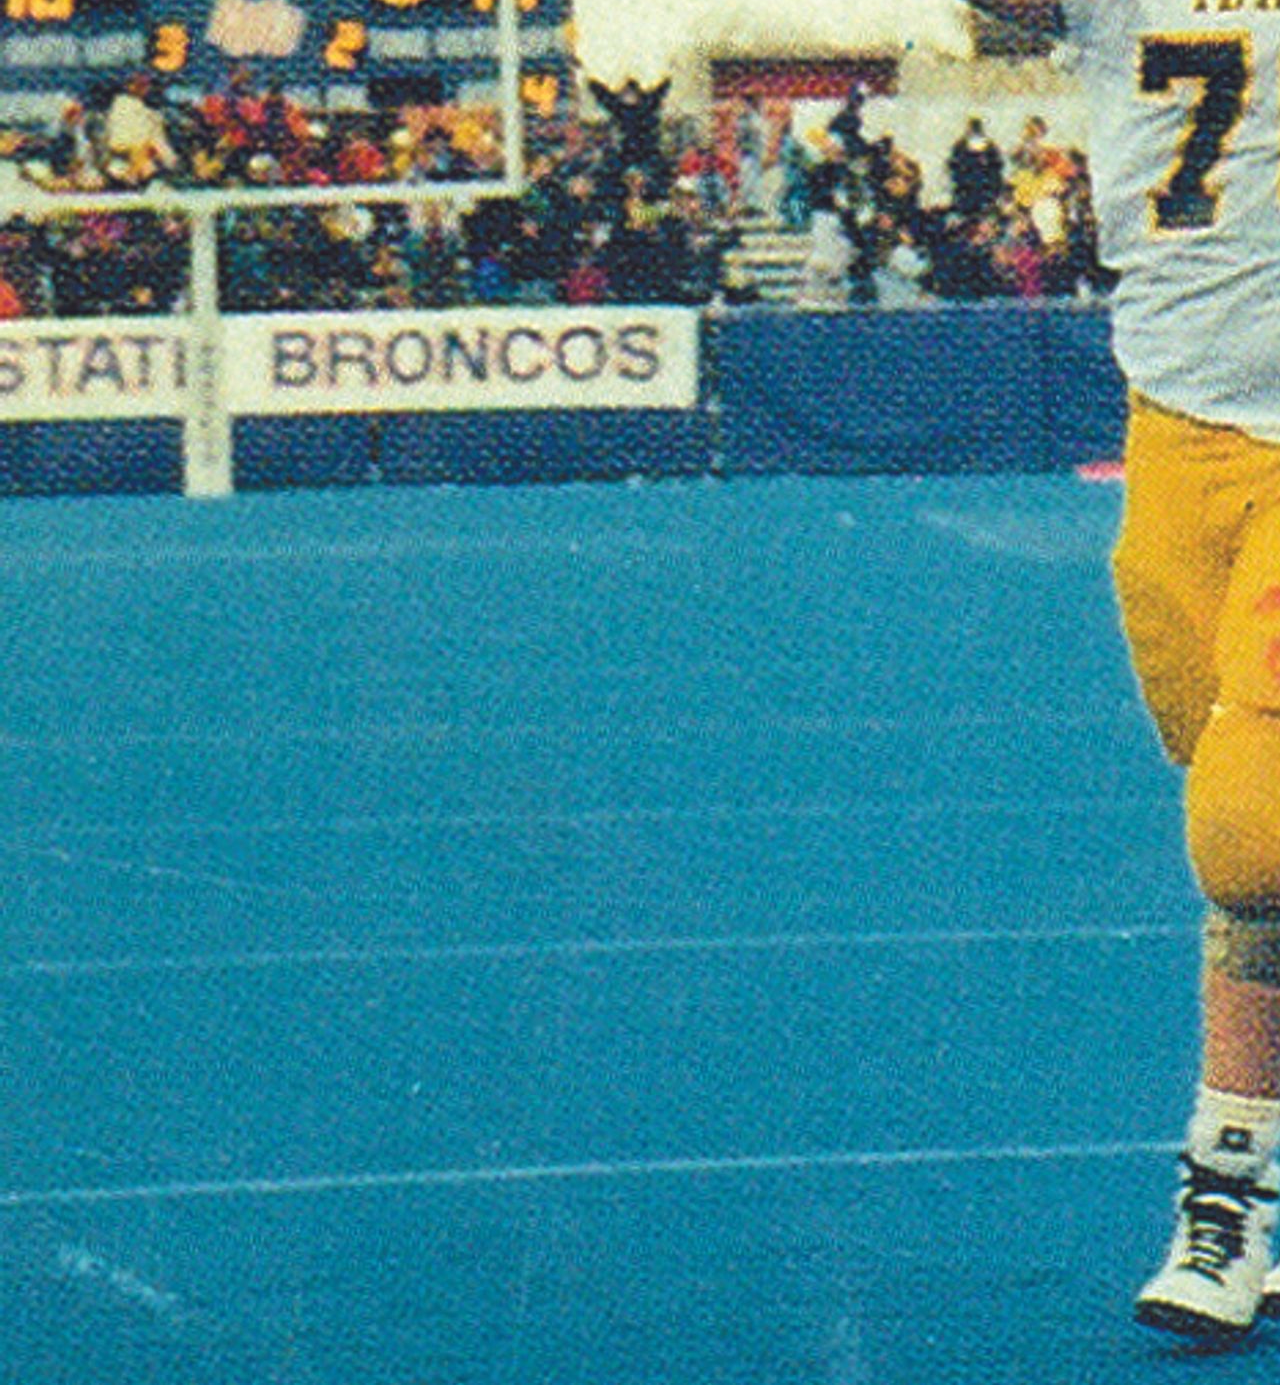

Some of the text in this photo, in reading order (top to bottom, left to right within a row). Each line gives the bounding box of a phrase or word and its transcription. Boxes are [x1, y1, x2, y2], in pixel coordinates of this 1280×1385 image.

[152, 23, 190, 71] 3
[323, 19, 366, 69] 2
[0, 334, 188, 393] STAT
[272, 325, 662, 389] BRONCOS
